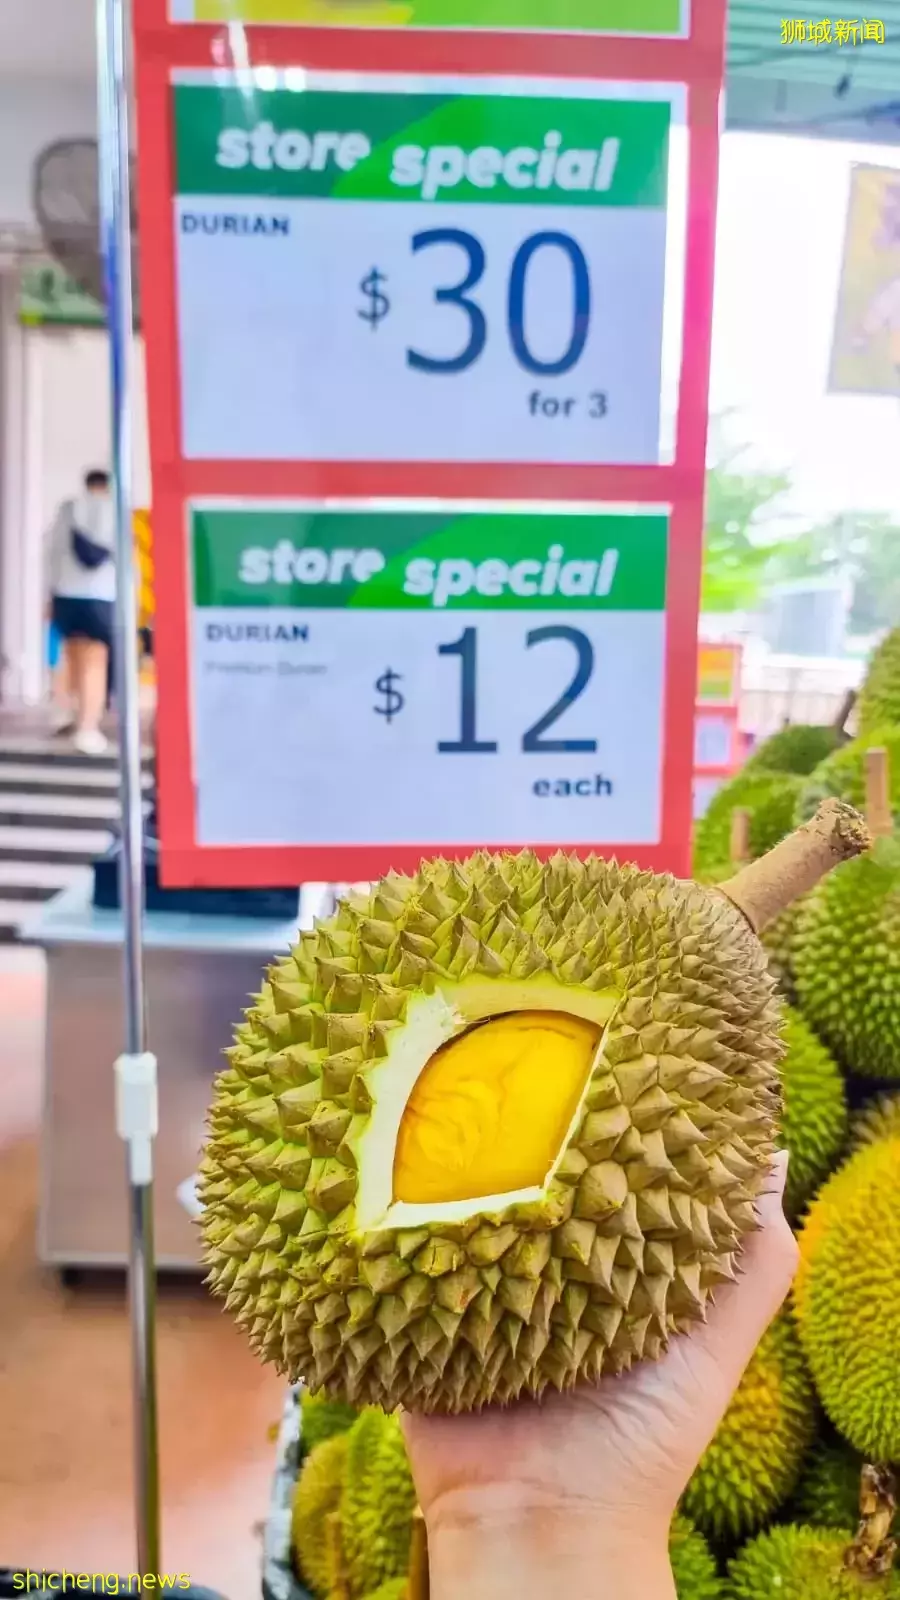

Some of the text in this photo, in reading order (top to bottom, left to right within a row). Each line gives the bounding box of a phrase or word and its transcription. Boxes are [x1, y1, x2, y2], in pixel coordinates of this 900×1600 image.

[214, 121, 619, 200] store special
[181, 213, 289, 237] DURIAN
[528, 392, 608, 418] for 3
[239, 540, 619, 607] store special
[206, 624, 309, 642] DURIAN
[532, 774, 613, 798] each
